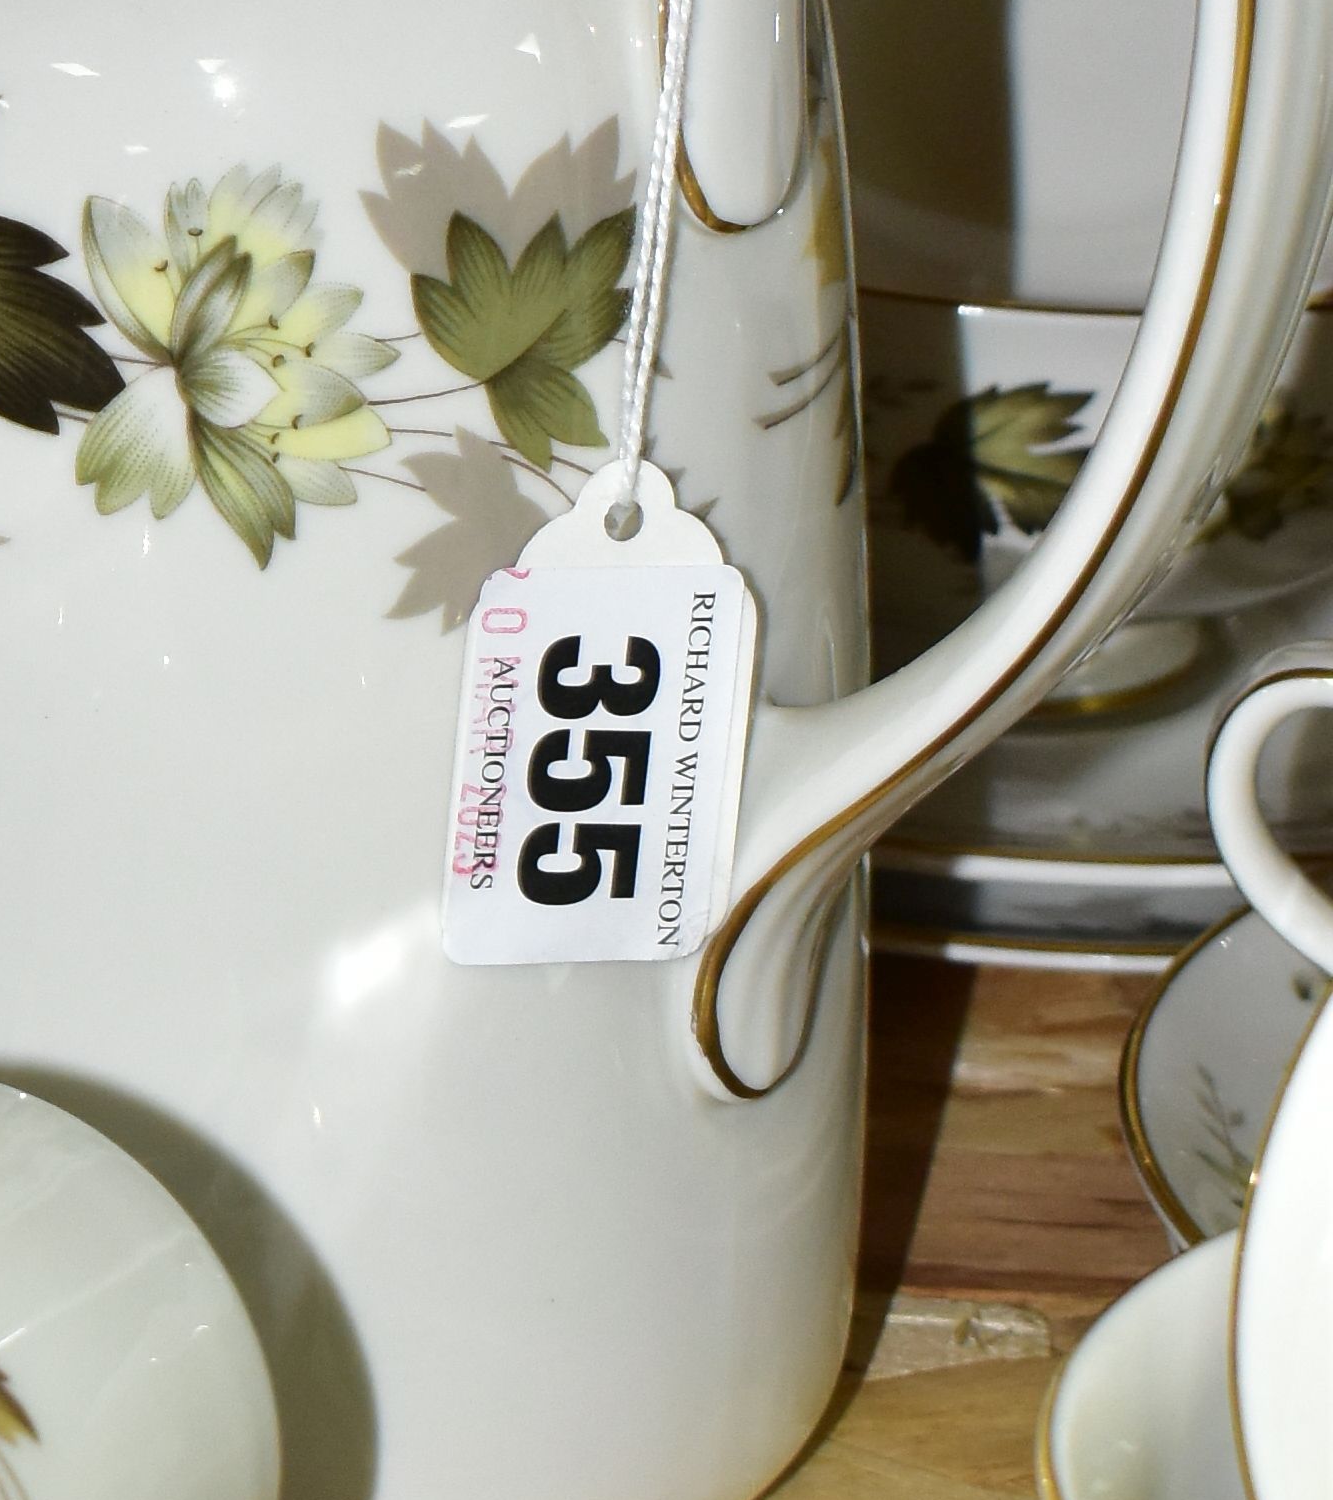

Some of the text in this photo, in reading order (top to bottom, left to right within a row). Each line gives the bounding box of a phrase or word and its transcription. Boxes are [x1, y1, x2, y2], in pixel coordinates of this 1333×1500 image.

[470, 656, 516, 890] AUCTIONEERS
[517, 634, 661, 906] 355
[656, 591, 716, 946] RICHARD WINTERTON
